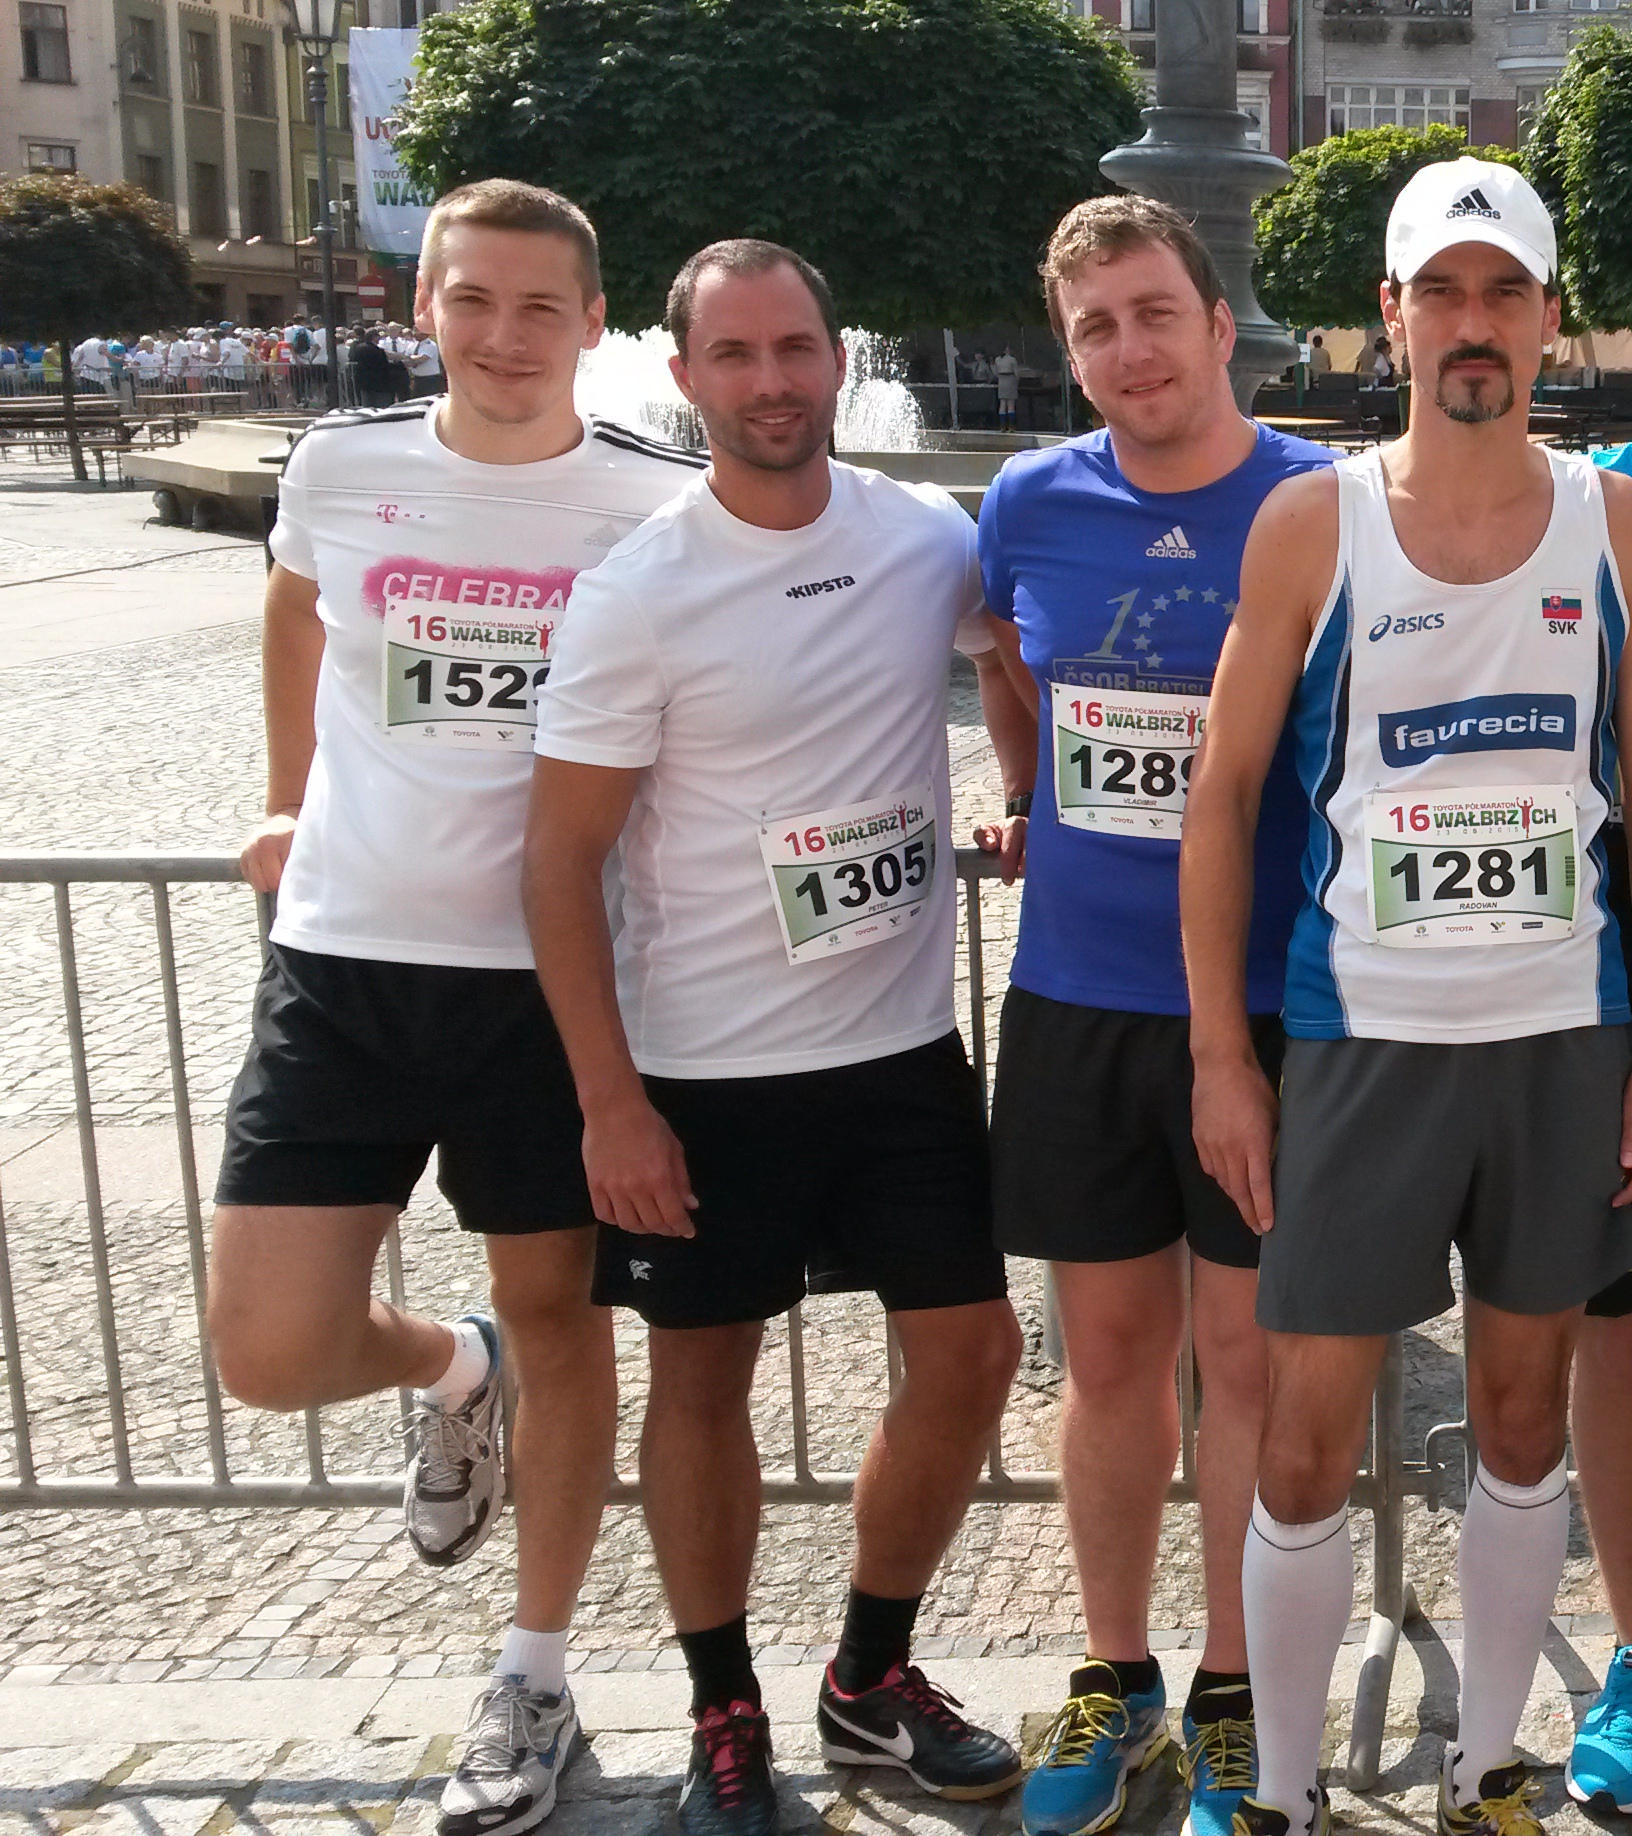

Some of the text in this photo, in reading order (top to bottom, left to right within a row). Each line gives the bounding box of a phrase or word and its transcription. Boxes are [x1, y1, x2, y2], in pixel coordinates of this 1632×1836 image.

[1446, 208, 1501, 220] adidas
[1145, 546, 1197, 559] adidas
[407, 614, 447, 641] 16
[1393, 612, 1445, 634] asics
[1548, 620, 1577, 635] SVK
[1069, 700, 1103, 727] 16
[1389, 804, 1431, 833] 16
[784, 826, 826, 856] 16
[795, 841, 926, 917] 1305
[1391, 846, 1548, 902] 1281
[868, 901, 889, 912] PETER
[1459, 902, 1498, 910] RADOVAN
